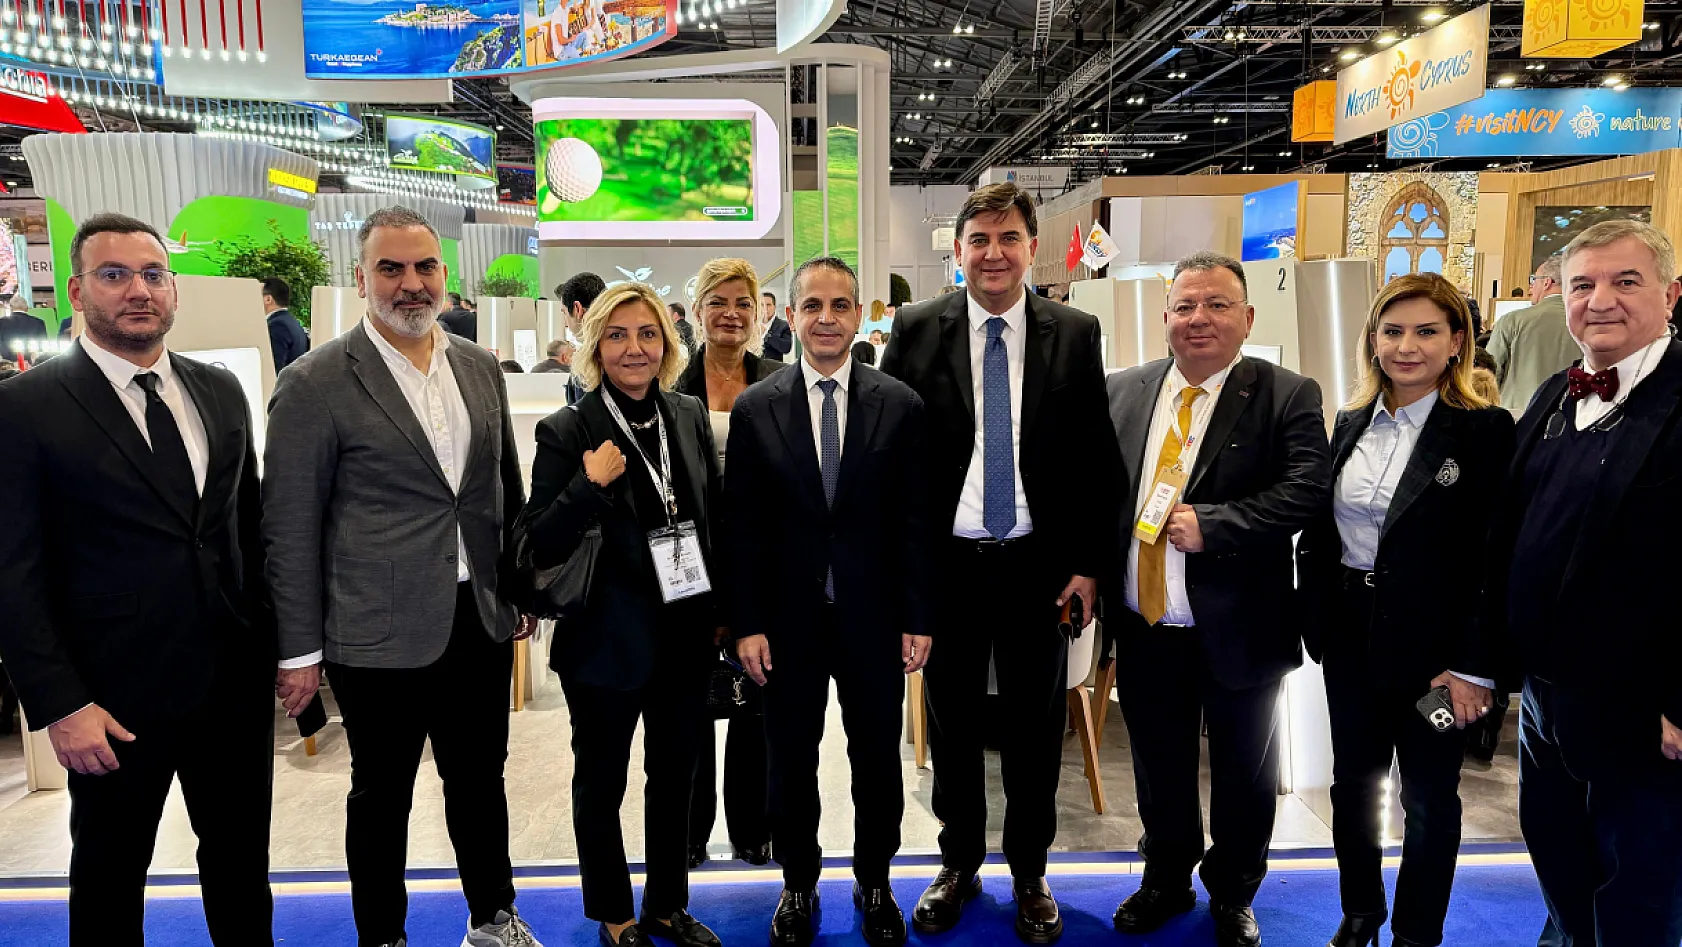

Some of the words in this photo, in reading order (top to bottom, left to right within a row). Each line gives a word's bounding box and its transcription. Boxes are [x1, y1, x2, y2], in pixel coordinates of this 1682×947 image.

[309, 53, 378, 62] TURKAEGEAN
[1344, 86, 1382, 119] NORTH
[1420, 49, 1472, 91] CYPRUS
[1455, 107, 1565, 136] #visitNCY
[1609, 107, 1672, 132] nature
[1277, 267, 1287, 291] 2
